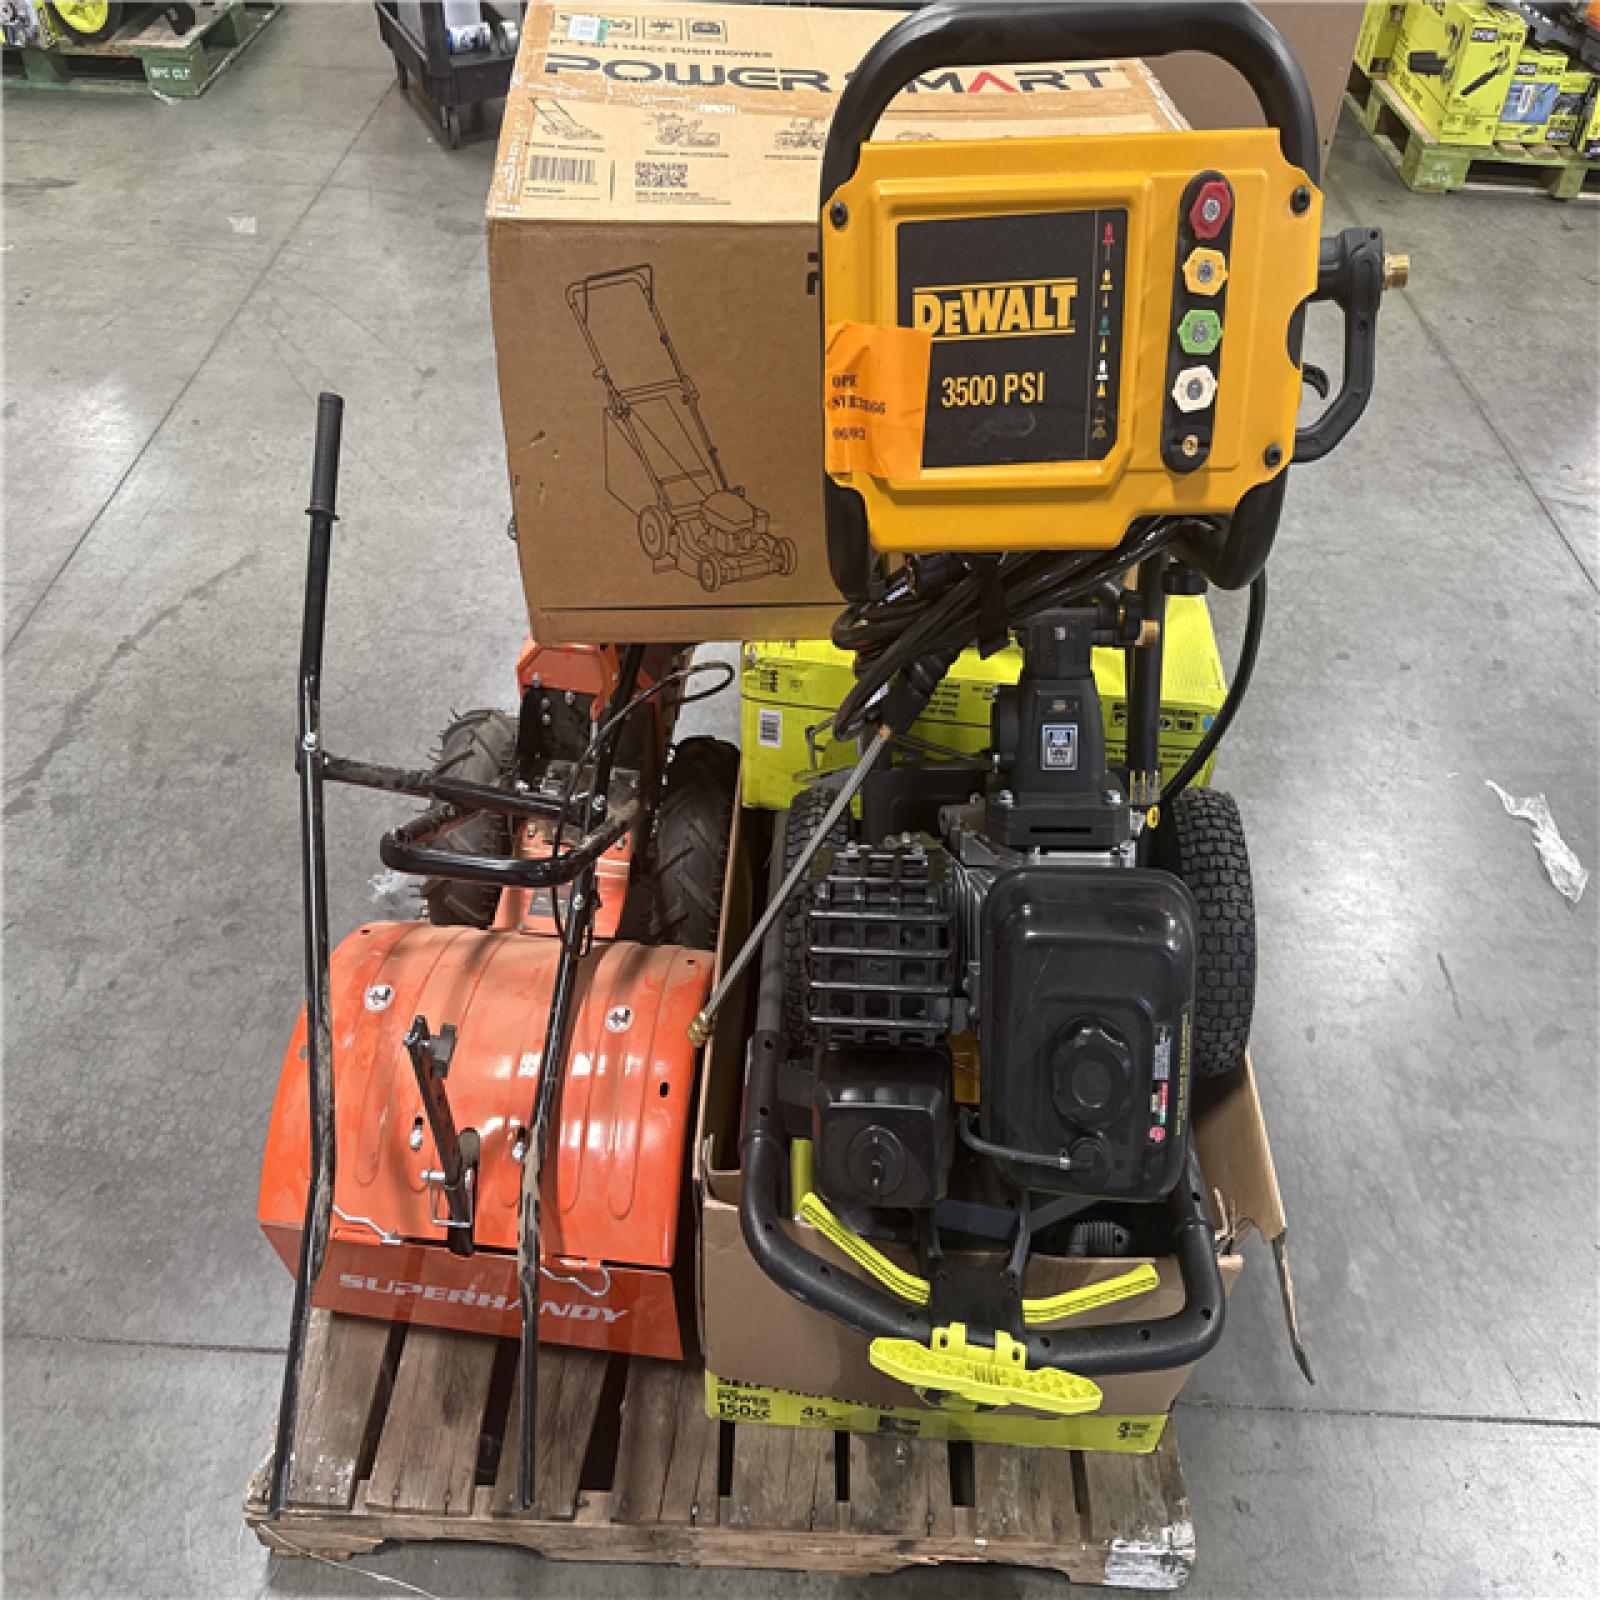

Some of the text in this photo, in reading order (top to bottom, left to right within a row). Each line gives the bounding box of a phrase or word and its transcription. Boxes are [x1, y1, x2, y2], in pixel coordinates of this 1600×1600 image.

[544, 52, 1110, 93] POWER MART
[941, 371, 1046, 408] 3500 PSI
